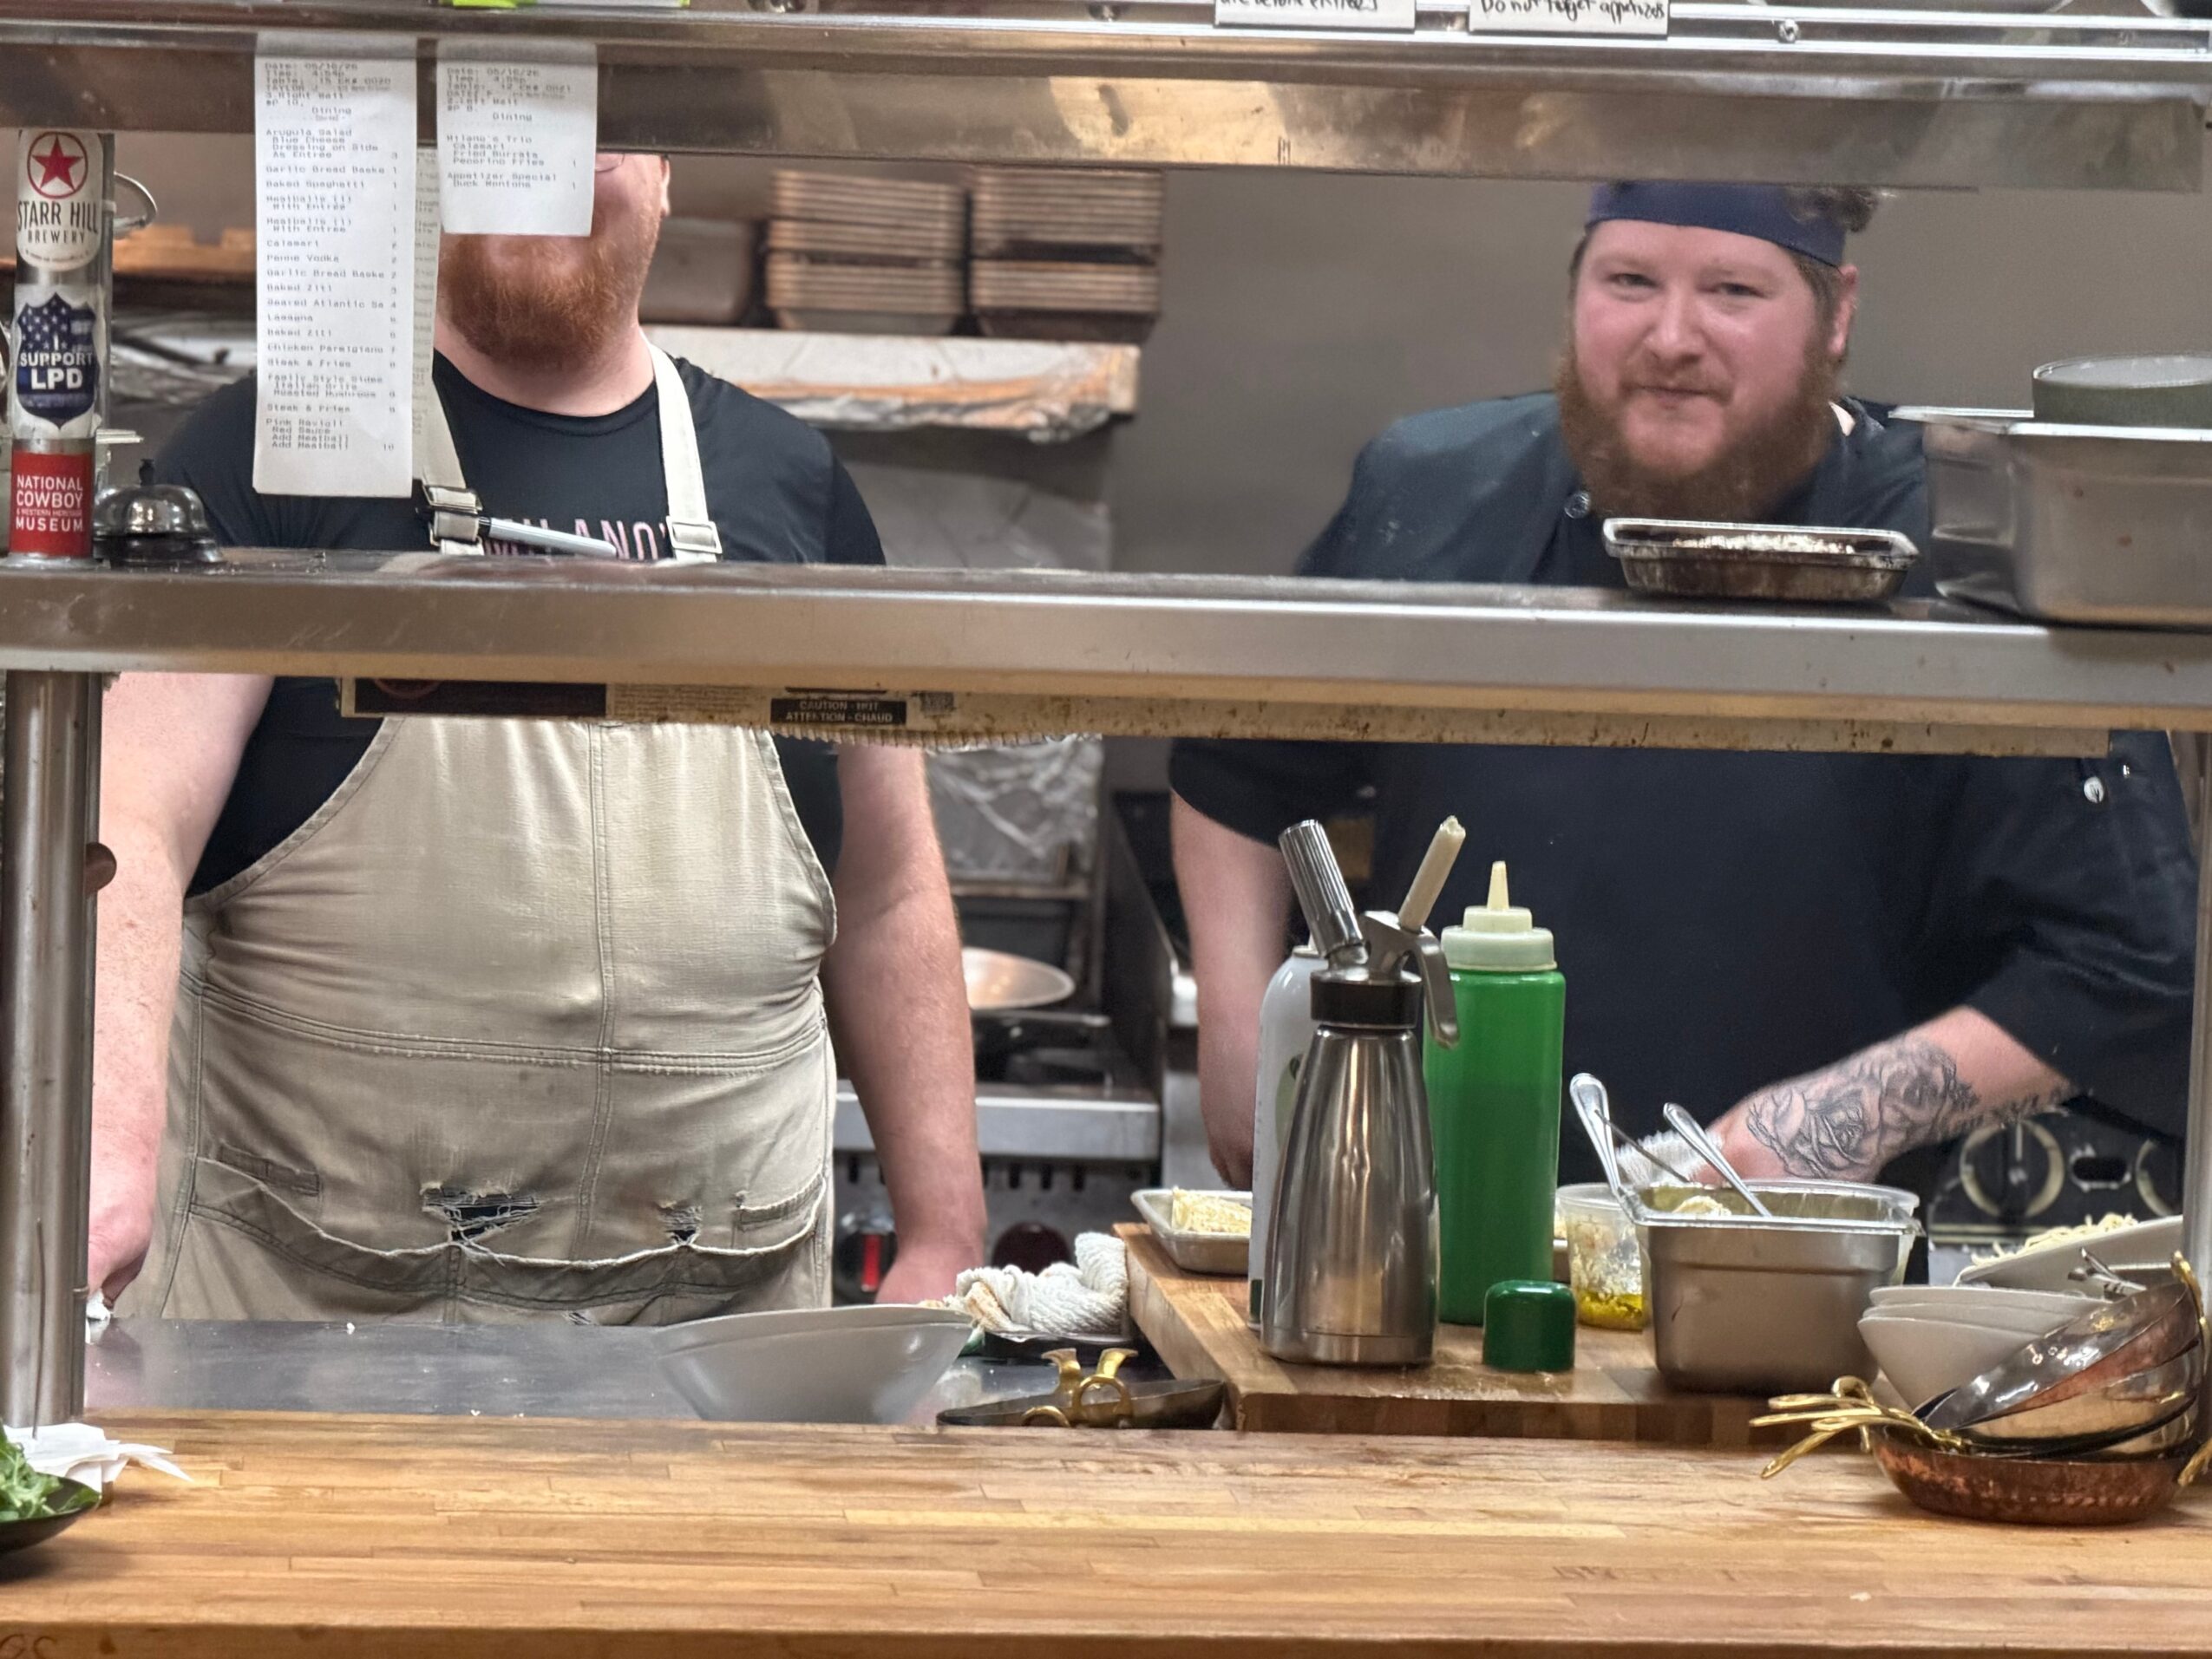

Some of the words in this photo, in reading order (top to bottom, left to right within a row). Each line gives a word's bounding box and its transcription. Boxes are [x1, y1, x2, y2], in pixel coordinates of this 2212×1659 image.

[1480, 0, 1506, 14] Do
[17, 200, 62, 232] STARR
[70, 201, 98, 234] HILL
[28, 230, 84, 243] BREWERY
[20, 352, 93, 368] SUPPORT
[31, 368, 83, 390] LPD
[17, 474, 83, 491] NATIONAL
[16, 490, 83, 509] COWBOY
[16, 516, 83, 532] MUSEUM
[800, 701, 847, 710] CAUTION
[854, 712, 893, 722] CHAUD
